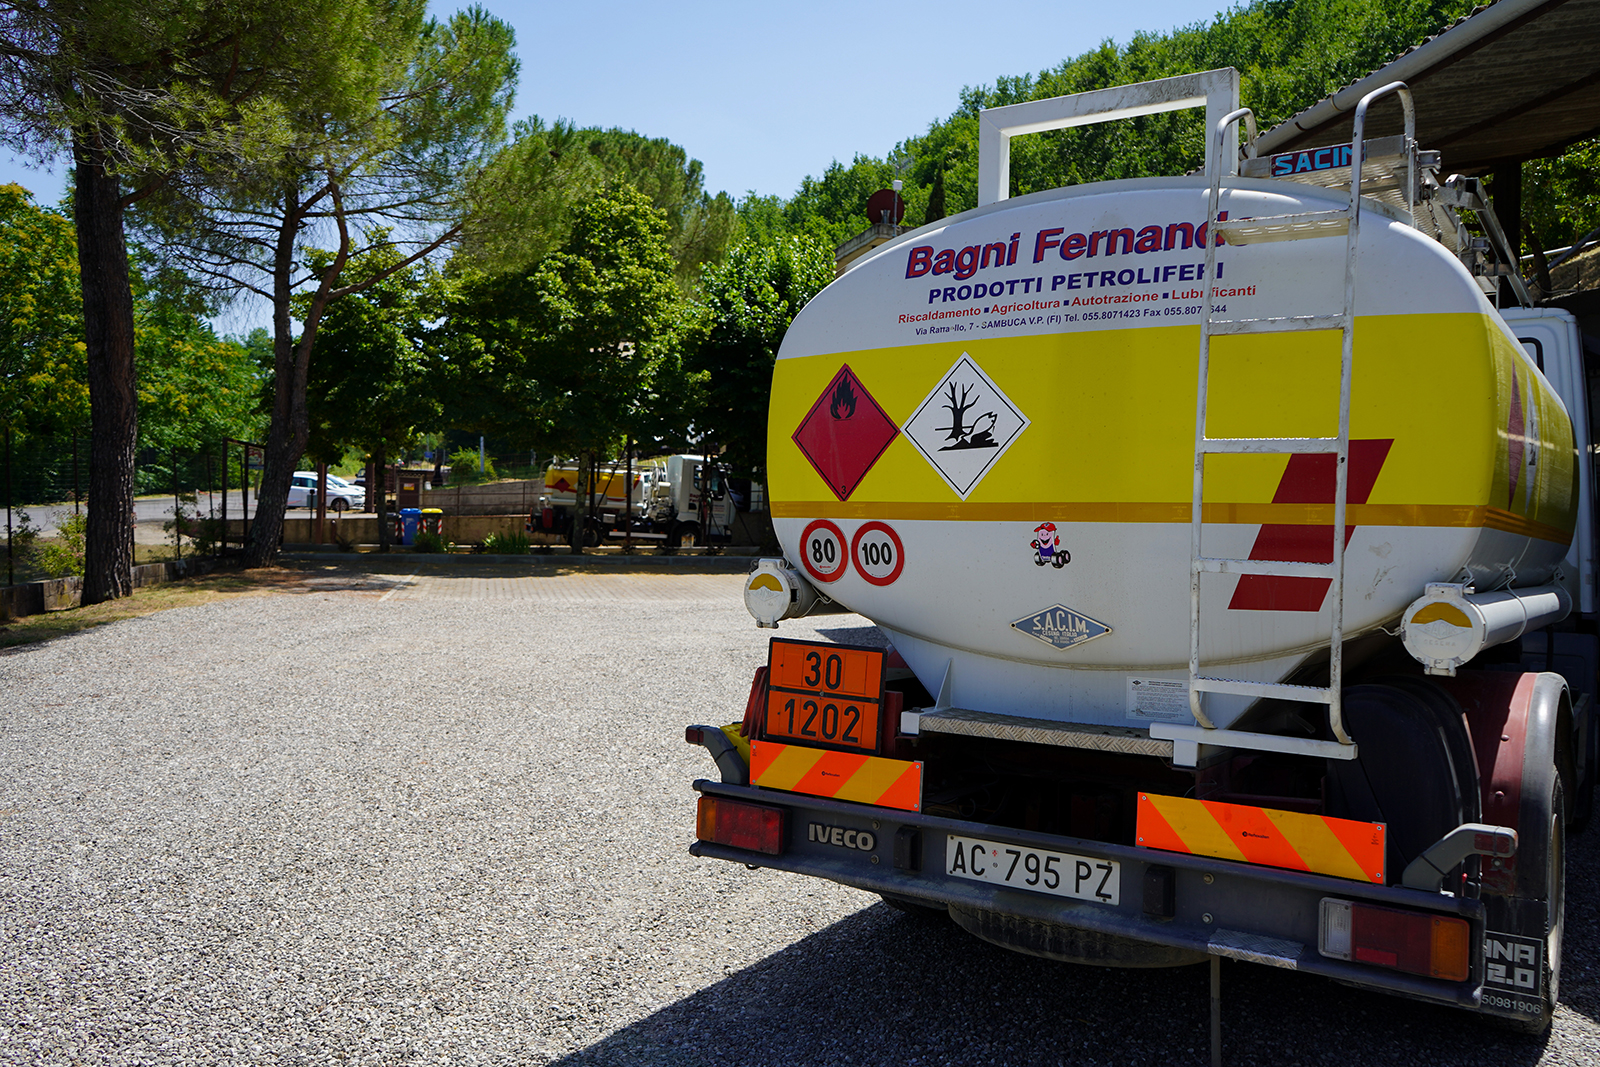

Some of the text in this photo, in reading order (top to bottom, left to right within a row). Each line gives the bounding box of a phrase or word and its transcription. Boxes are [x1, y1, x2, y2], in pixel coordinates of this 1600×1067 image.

[905, 210, 1253, 281] Bagni Fernand
[928, 277, 1043, 304] PRODOTTI
[898, 307, 981, 324] Riscaldamento
[991, 298, 1061, 315] Agricoltura
[1071, 292, 1159, 307] Autotrazione
[915, 328, 928, 336] Via
[969, 322, 975, 331] 7
[981, 316, 1027, 329] SAMBUCA
[1028, 315, 1044, 325] V.P.
[1047, 314, 1062, 325] (FI)
[1064, 313, 1080, 323] Tel.
[1082, 309, 1141, 322] 055.8071423
[1143, 307, 1161, 318] Fax
[1164, 304, 1227, 317] 055.807644
[841, 485, 847, 495] 3
[811, 538, 836, 564] 80
[861, 542, 893, 566] 100
[1033, 610, 1090, 633] S.A.C.I.M.
[804, 651, 842, 690] 30
[784, 699, 861, 743] 1202
[808, 823, 875, 851] IVECO
[952, 841, 1113, 899] AC 795 PZ
[1486, 962, 1535, 989] 2.0
